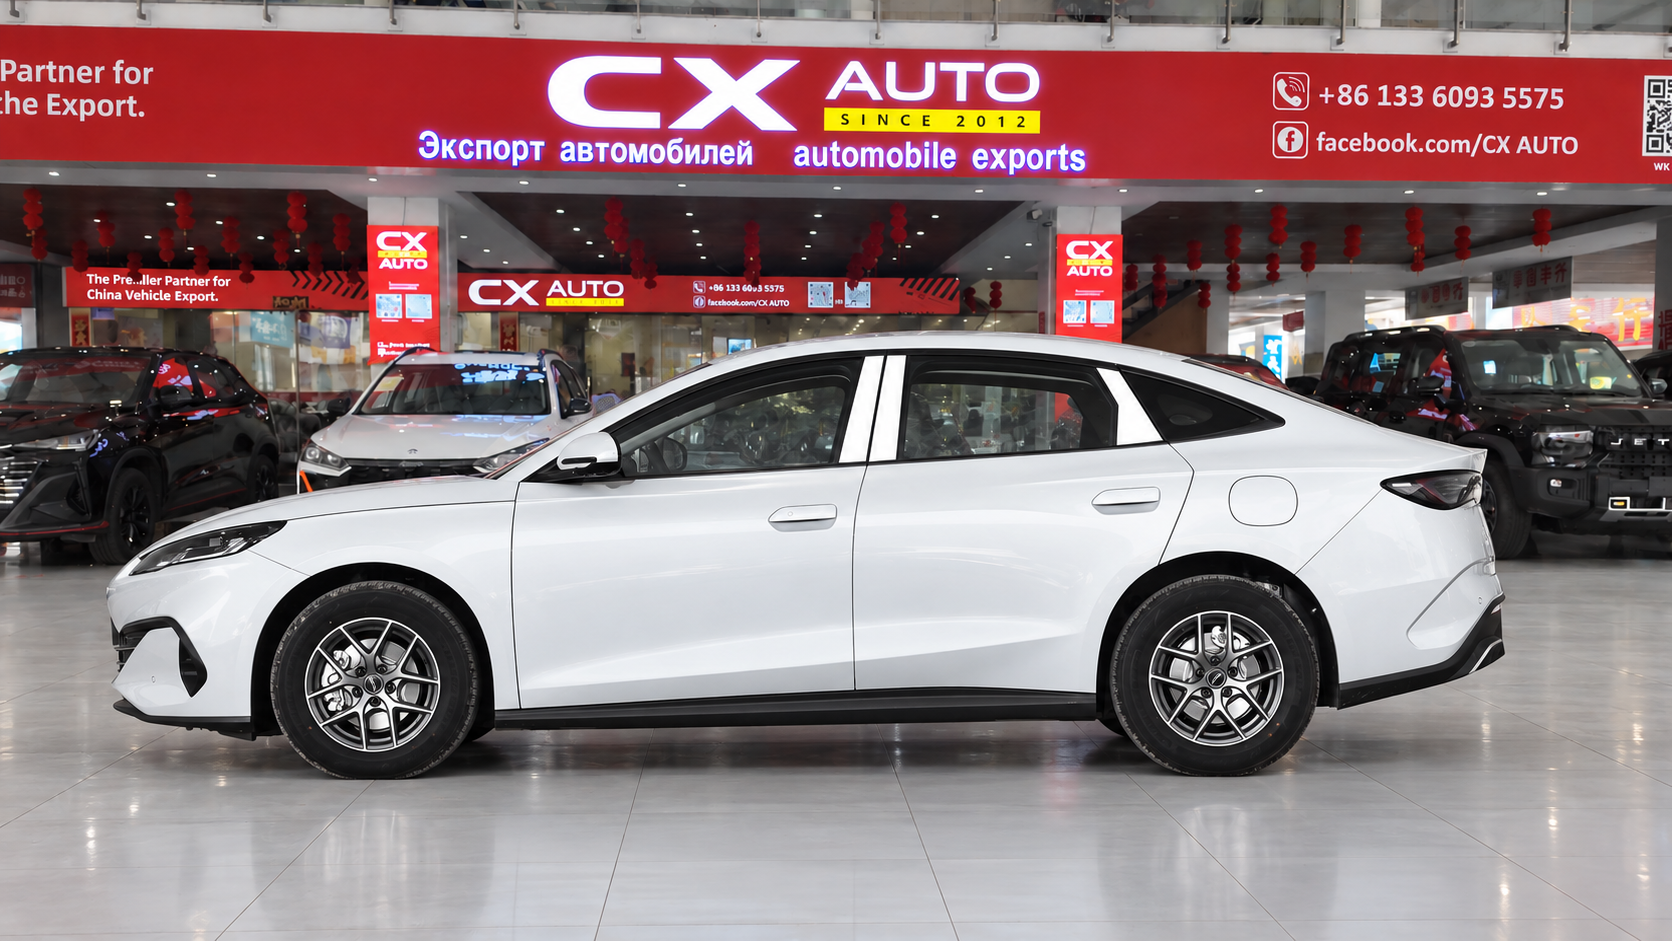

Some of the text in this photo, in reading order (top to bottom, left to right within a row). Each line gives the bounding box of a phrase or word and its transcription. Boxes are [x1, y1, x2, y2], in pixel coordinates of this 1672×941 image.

[0, 59, 154, 85] Partner for
[825, 60, 1041, 103] AUTO
[547, 55, 800, 132] CX
[1318, 83, 1564, 110] +86 133 6093 5575
[47, 93, 145, 122] Export.
[840, 113, 1026, 128] SINCE 2012
[418, 130, 754, 167] Экспорт автомобилей
[1316, 132, 1579, 157] facebook.com/CX AUTO
[793, 141, 1086, 175] automobile exports
[376, 231, 428, 251] CX
[1065, 240, 1114, 260] CX
[378, 257, 429, 270] AUTO
[1066, 265, 1113, 277] AUTO
[86, 274, 110, 285] The
[165, 276, 210, 287] Partner
[212, 276, 231, 287] for
[468, 279, 625, 306] CX AUTO
[86, 289, 219, 304] China Vehicle Export.
[1610, 438, 1670, 446] JET
